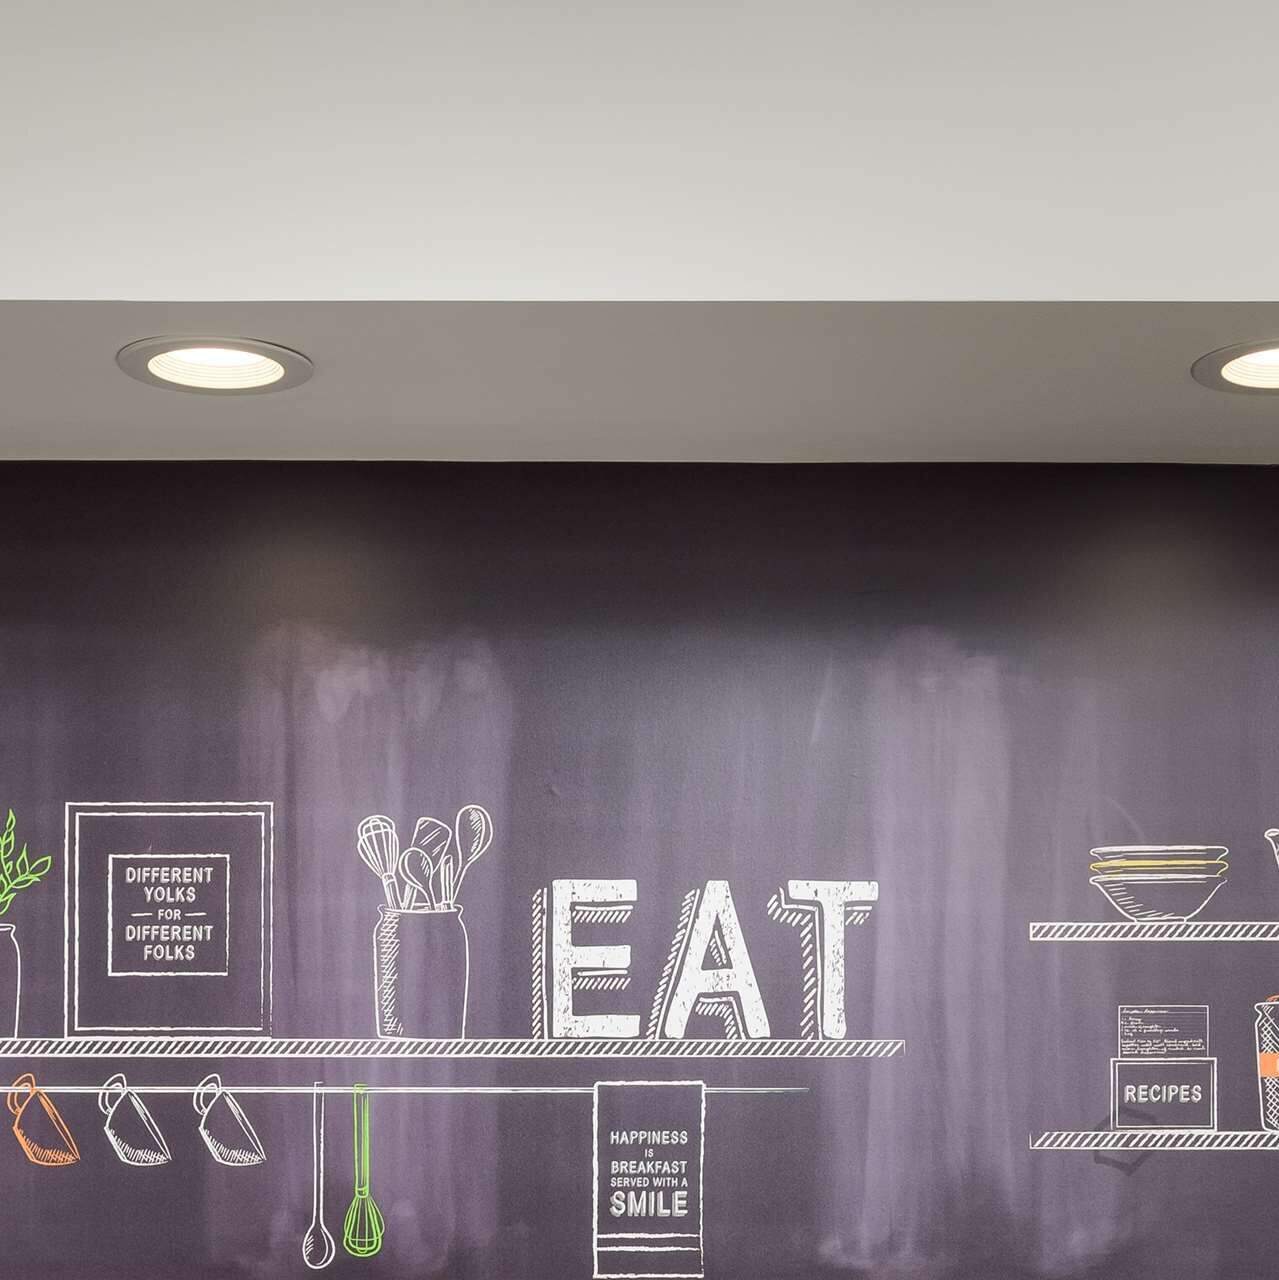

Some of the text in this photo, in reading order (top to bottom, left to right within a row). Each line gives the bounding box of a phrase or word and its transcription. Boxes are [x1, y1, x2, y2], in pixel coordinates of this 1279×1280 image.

[125, 867, 214, 884] DIFFERENT
[143, 886, 196, 903] YOLKS
[157, 908, 182, 921] FOR
[125, 925, 214, 941] DIFFERENT
[143, 944, 196, 961] FOLKS
[538, 878, 880, 1040] EAT
[1123, 1083, 1203, 1104] RECIPES
[609, 1130, 688, 1145] HAPPINESS
[644, 1148, 654, 1158] IS
[609, 1160, 688, 1175] BREAKFAST
[610, 1177, 689, 1188] SERVED WITH A
[609, 1190, 689, 1218] SMILE
